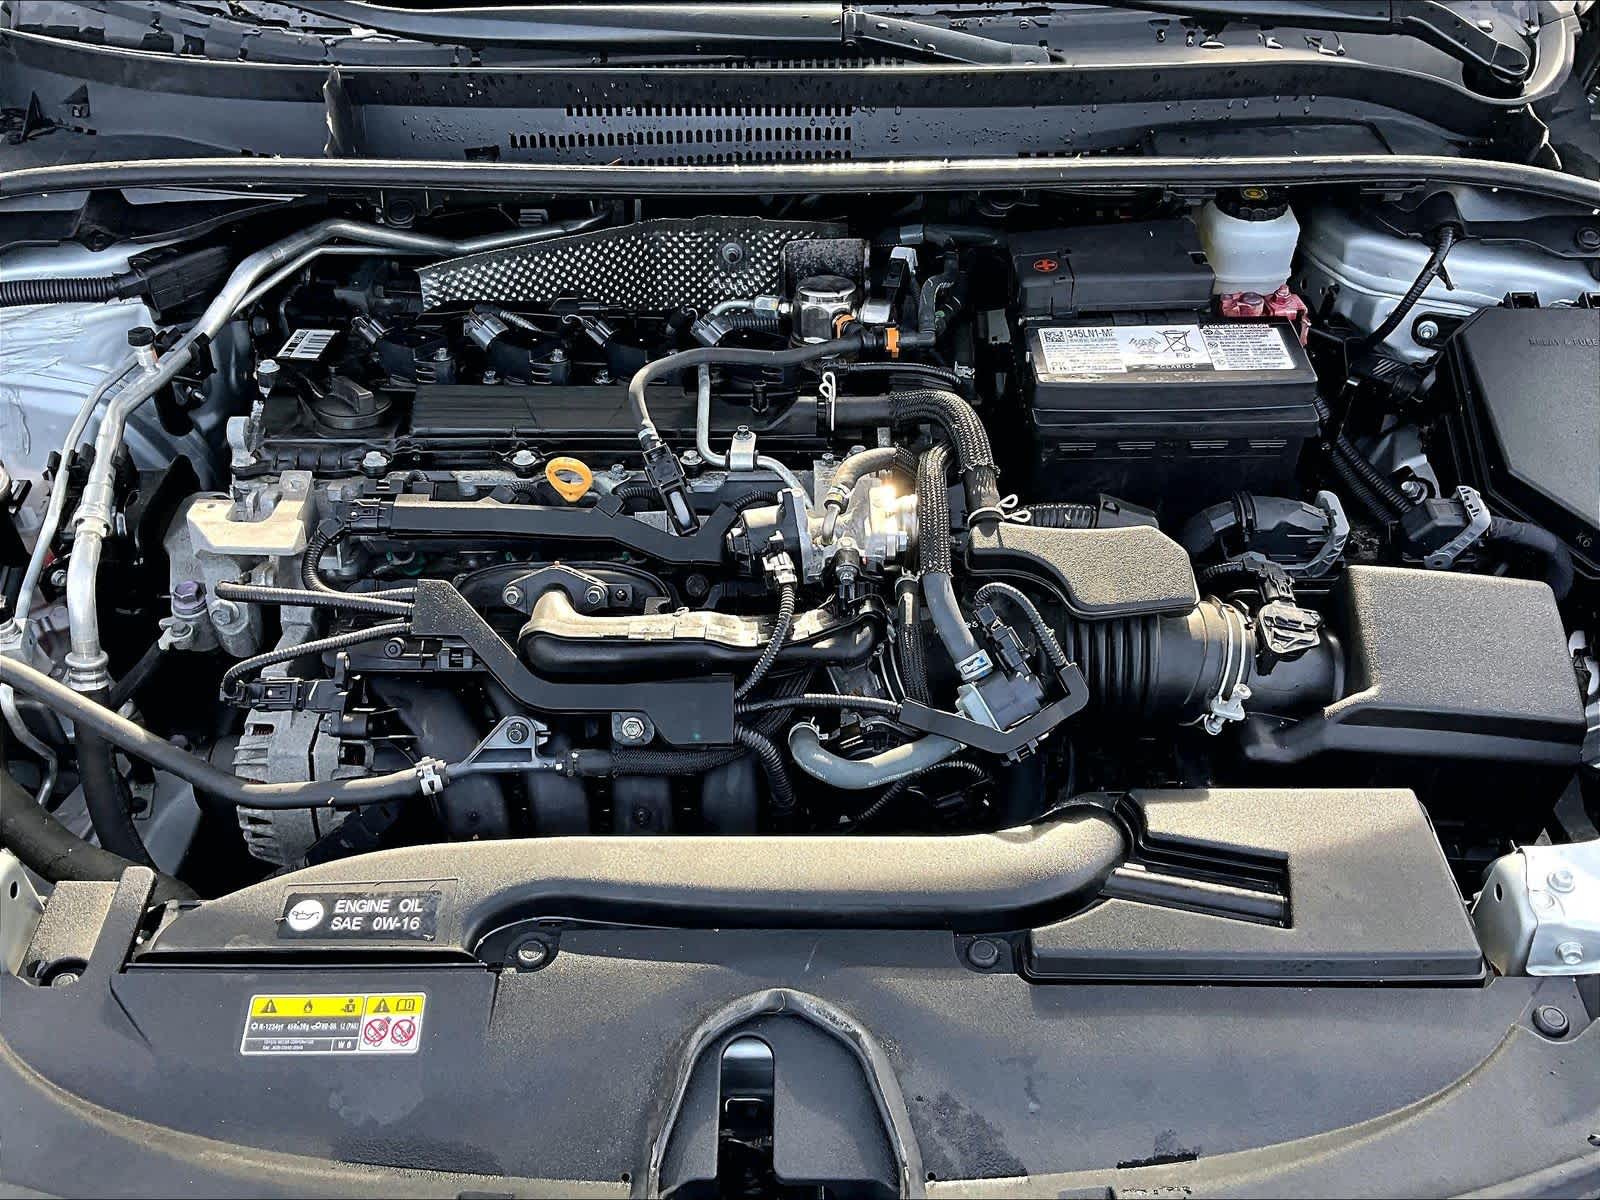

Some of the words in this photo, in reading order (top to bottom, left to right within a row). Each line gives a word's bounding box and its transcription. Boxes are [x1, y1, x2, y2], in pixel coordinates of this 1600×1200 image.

[335, 899, 390, 913] ENGINE
[399, 898, 423, 913] OIL
[331, 916, 363, 931] SAE
[373, 916, 420, 931] 0W-16
